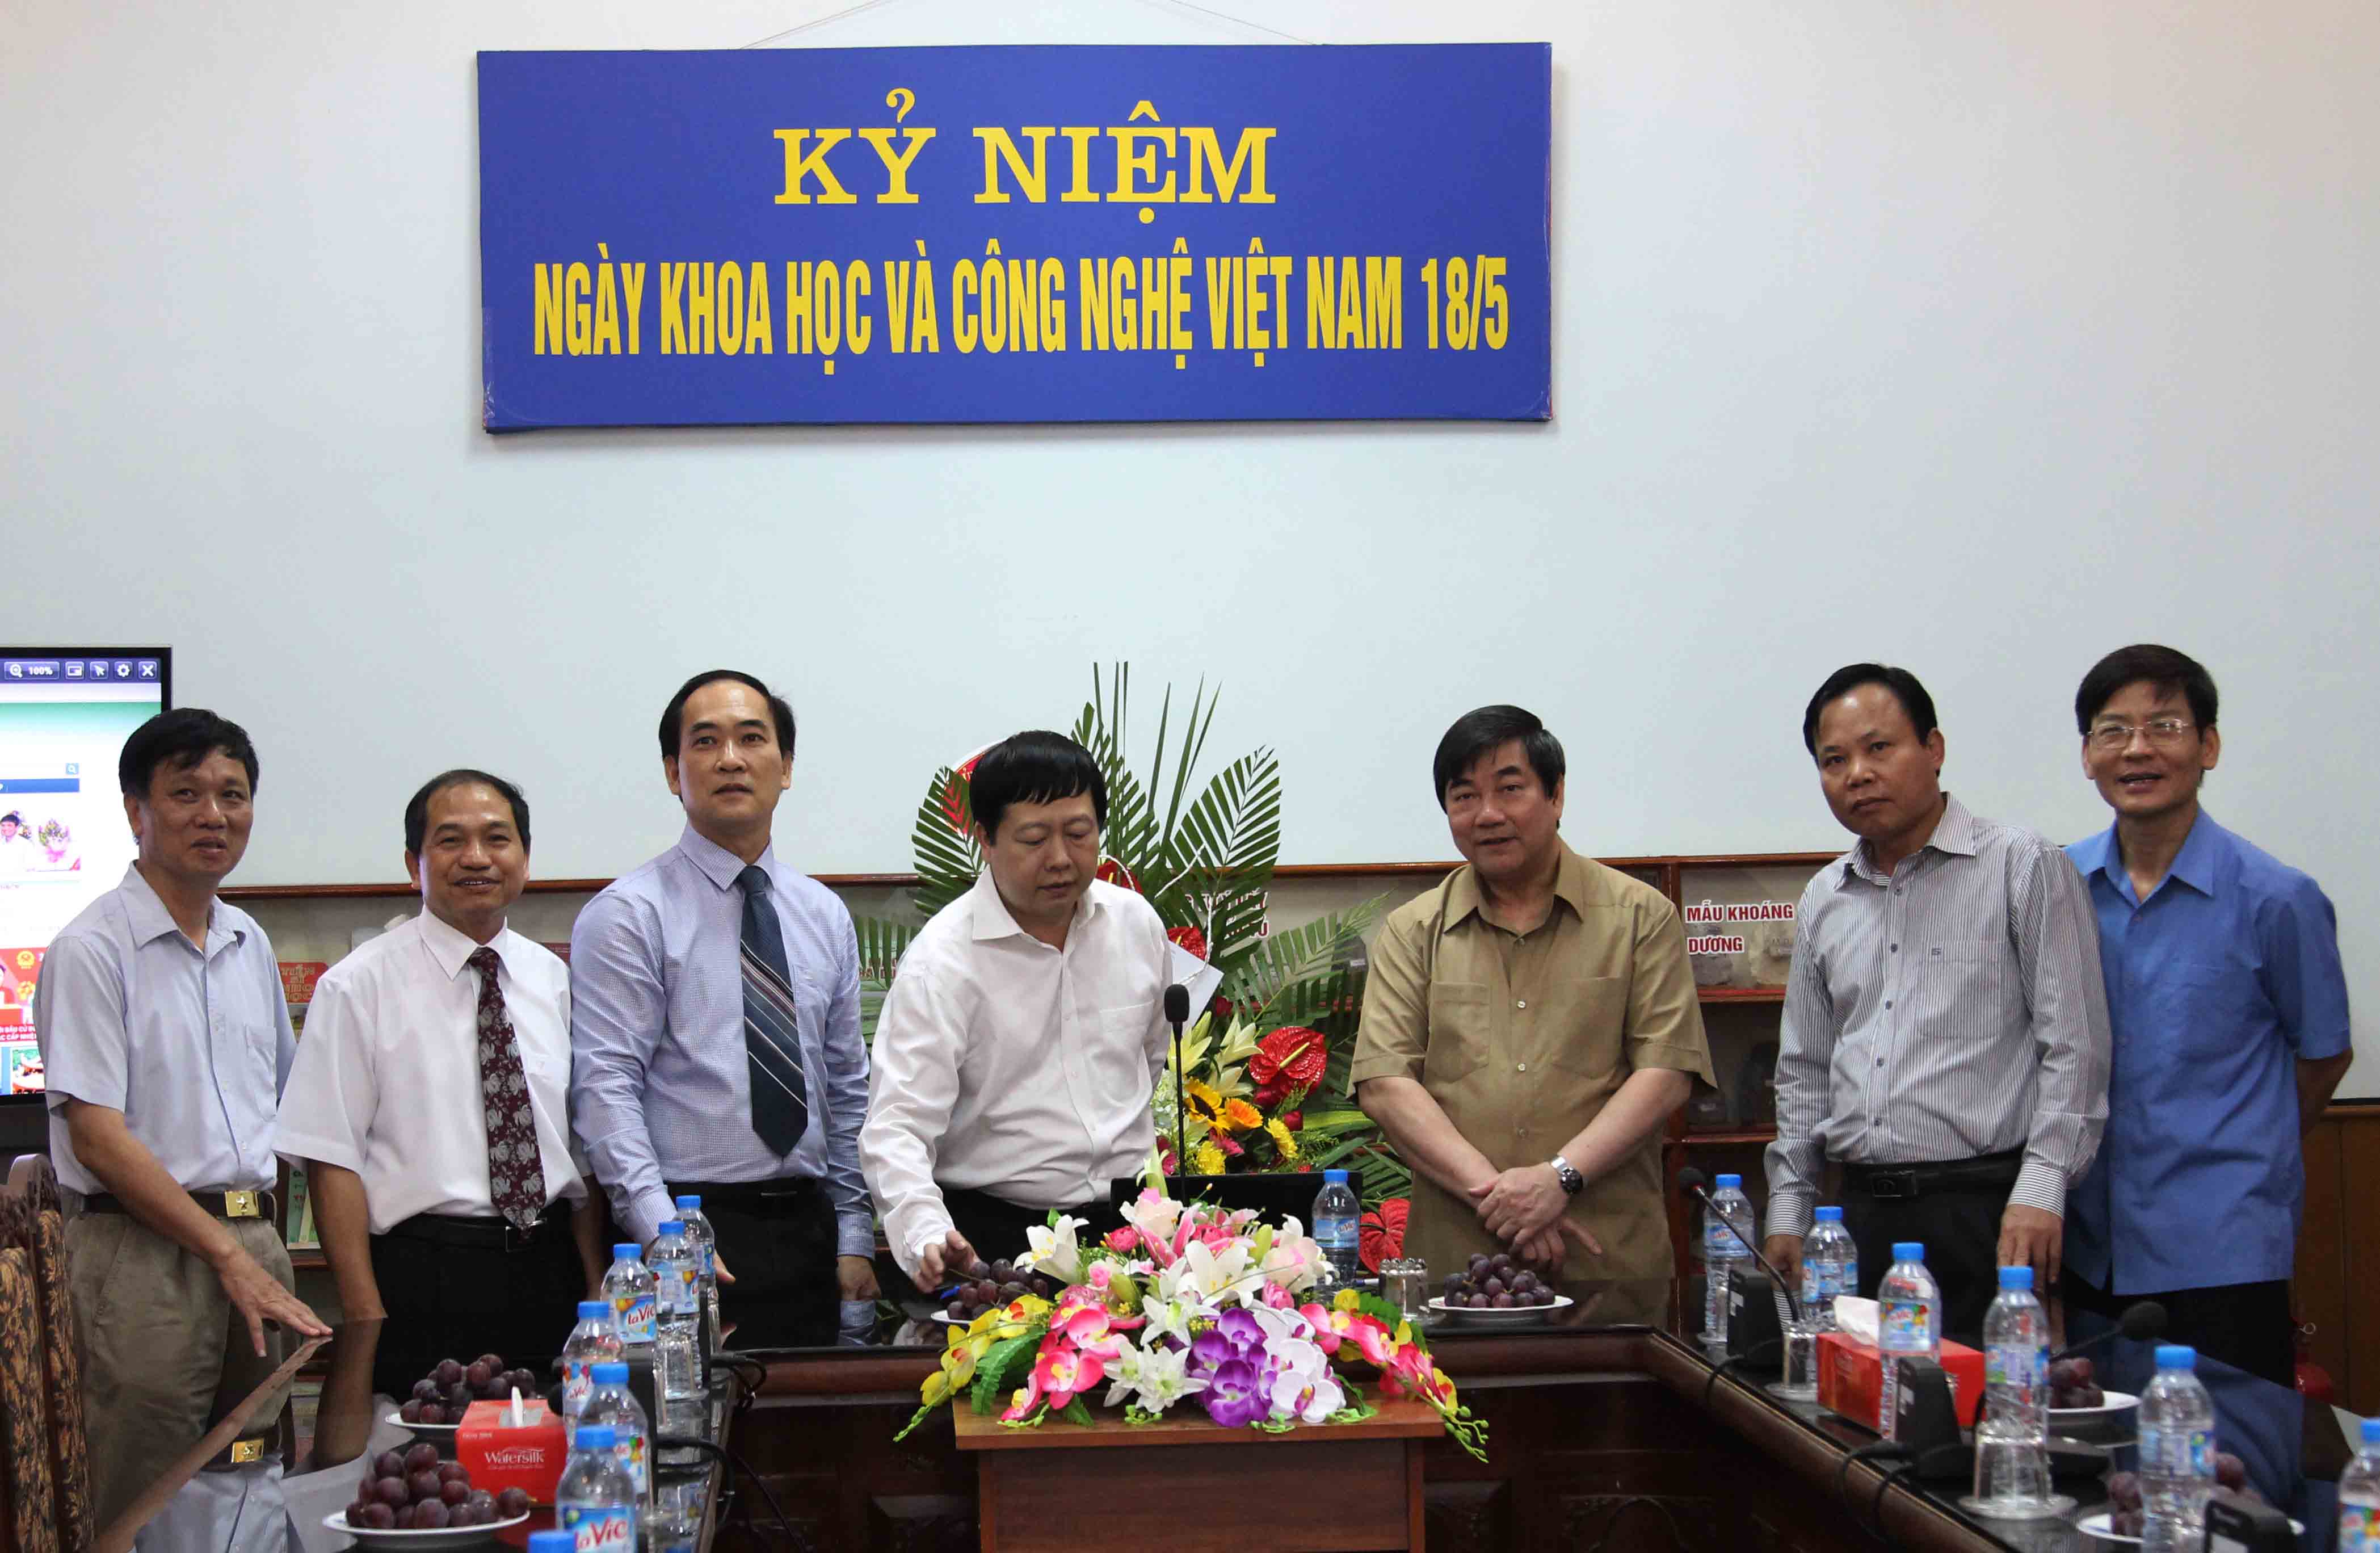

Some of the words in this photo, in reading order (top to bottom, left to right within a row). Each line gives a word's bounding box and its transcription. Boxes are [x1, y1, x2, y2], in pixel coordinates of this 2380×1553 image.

[775, 89, 936, 203] KỶ
[974, 100, 1276, 223] NIỆM
[535, 243, 645, 355] NGÀY
[661, 261, 772, 354] KHOA
[787, 261, 871, 374] HỌC
[885, 240, 939, 352] VÀ
[953, 239, 1065, 352] CÔNG
[1080, 238, 1192, 368] NGHỆ
[1206, 238, 1292, 366] VIỆT
[1307, 257, 1402, 348] NAM
[1422, 255, 1508, 349] 18/5
[29, 666, 53, 675] 100%
[1687, 900, 1723, 922] MẪU
[1727, 900, 1794, 921] KHOÁNG
[1688, 936, 1743, 954] DƯƠNG
[484, 1451, 545, 1463] Watersilk
